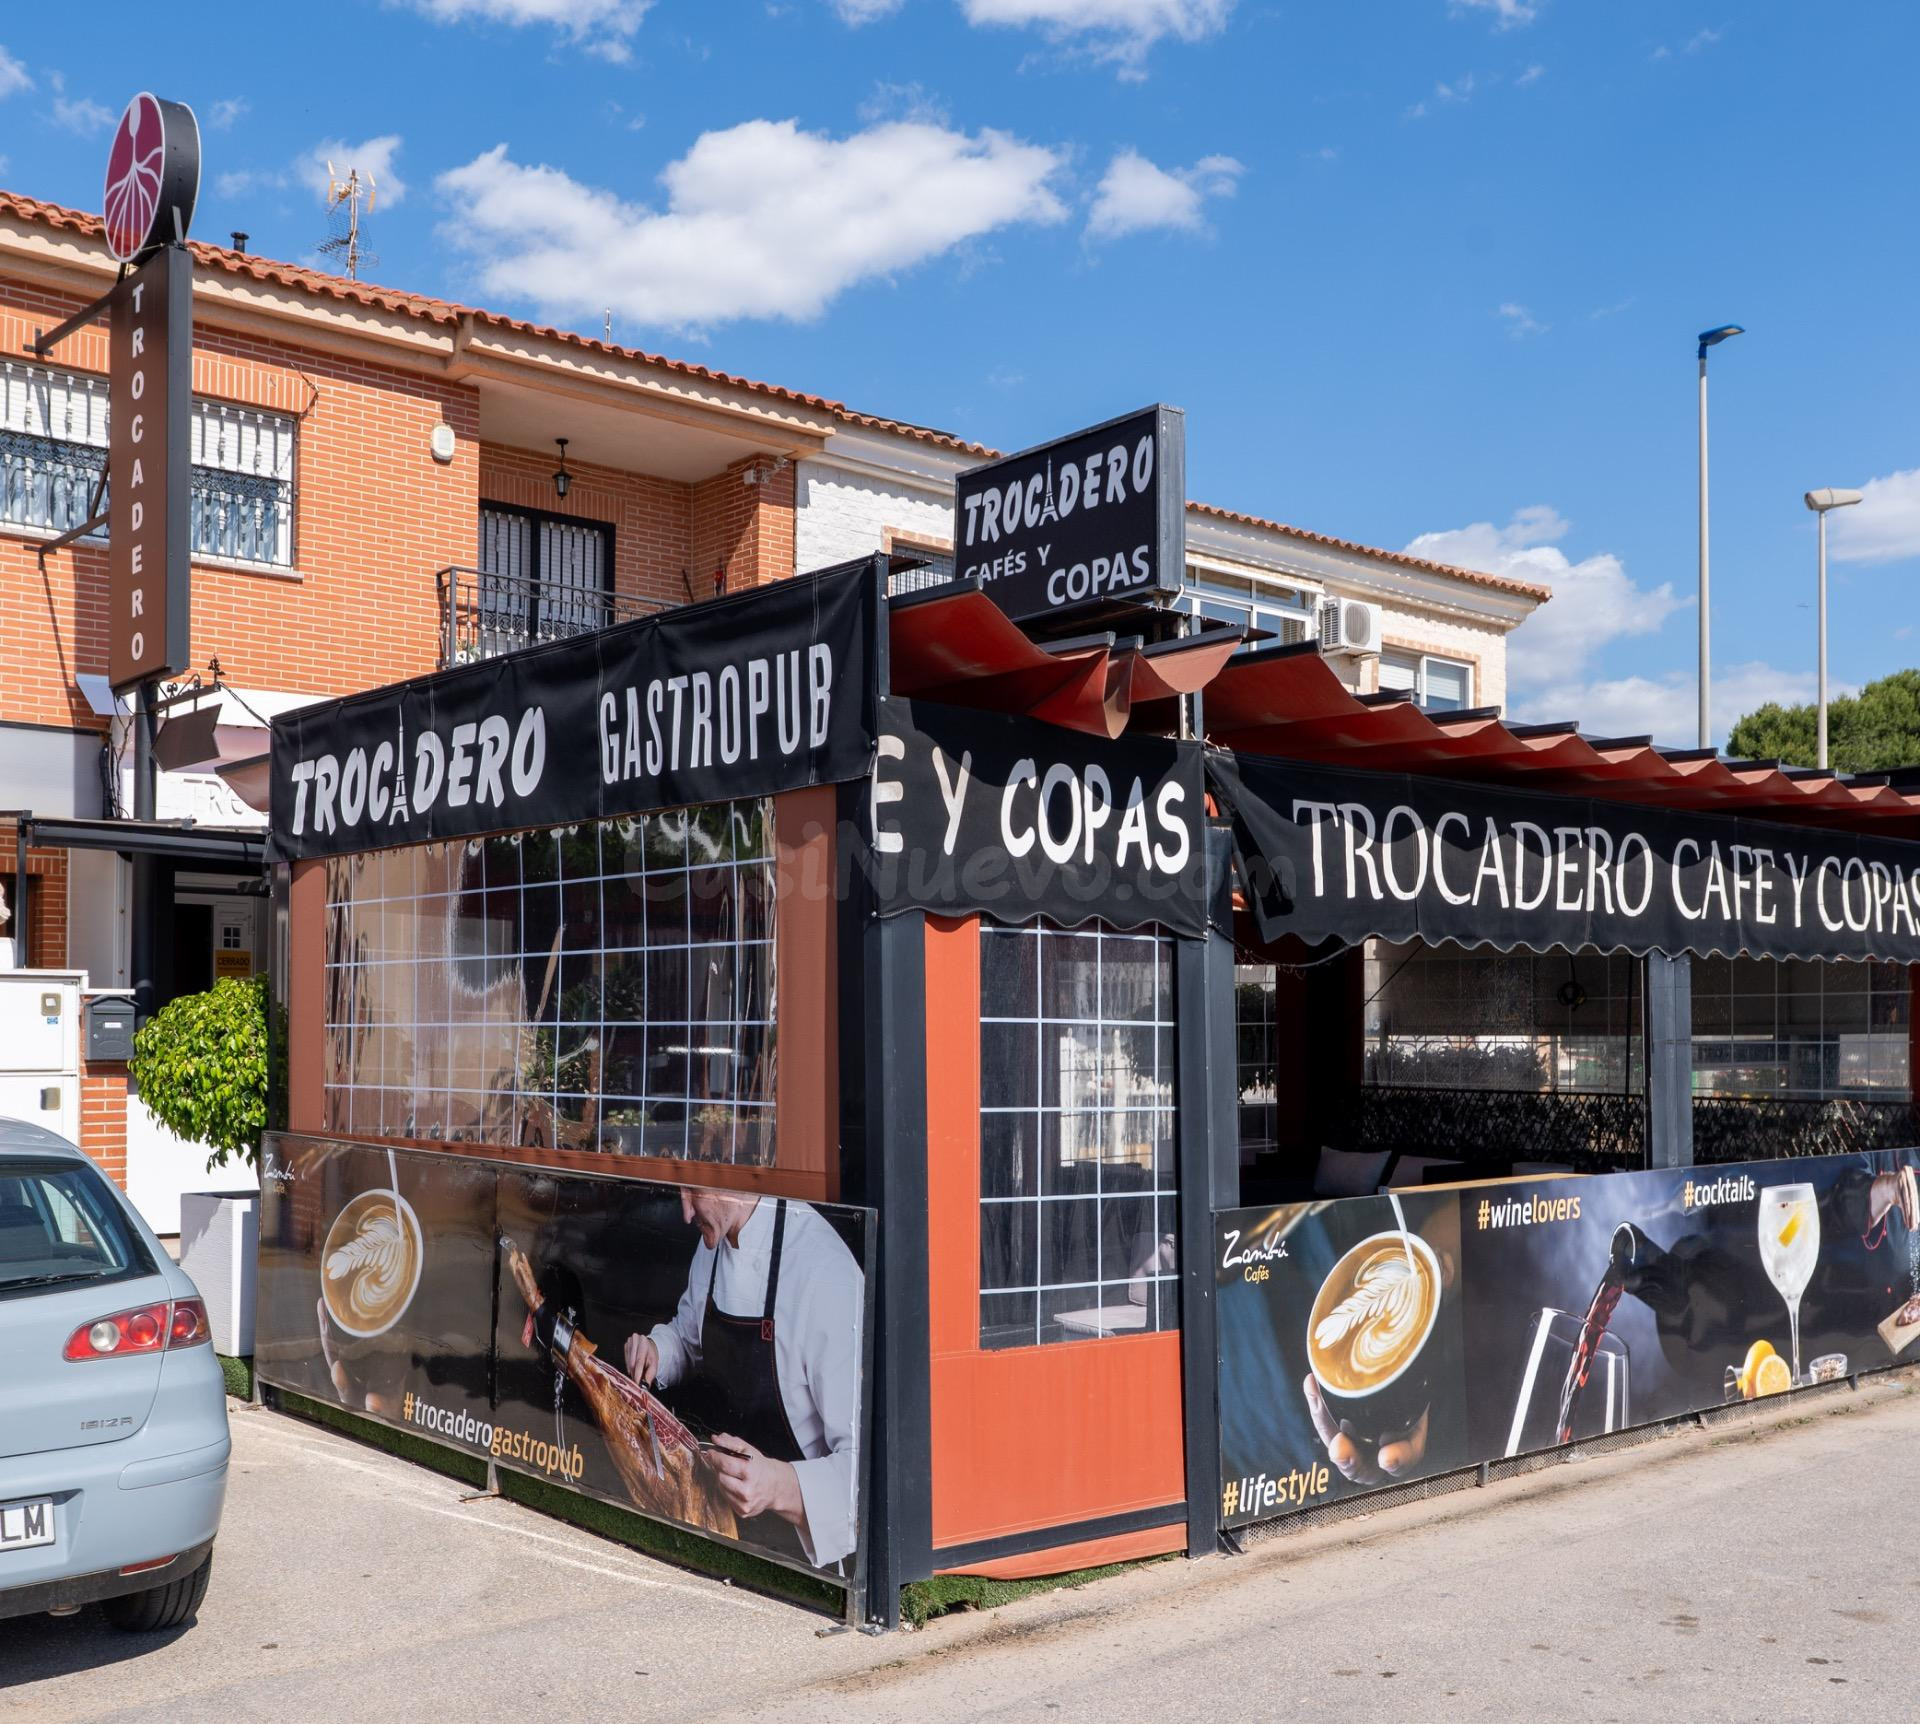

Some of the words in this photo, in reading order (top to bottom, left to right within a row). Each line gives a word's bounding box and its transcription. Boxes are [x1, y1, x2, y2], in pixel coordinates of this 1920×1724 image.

[131, 282, 145, 662] TROCADERO
[964, 434, 1154, 546] TROCADERO
[1037, 544, 1051, 566] Y
[1047, 545, 1150, 606] COPAS
[290, 704, 547, 837] TROCADERO
[599, 642, 833, 786] GASTROPUB
[932, 746, 973, 856] Y
[1001, 758, 1191, 875] COPAS
[1292, 798, 1654, 918] TROCADERO
[1671, 838, 1777, 924] CAFE
[1784, 852, 1809, 928] Y
[1478, 1194, 1581, 1230] #winelovers
[1684, 1174, 1755, 1208] #cocktails
[1244, 1264, 1270, 1285] Cafés
[80, 1416, 133, 1430] IBIZA
[402, 1391, 584, 1479] #trocaderogastropub
[1223, 1461, 1330, 1517] #lifestyle
